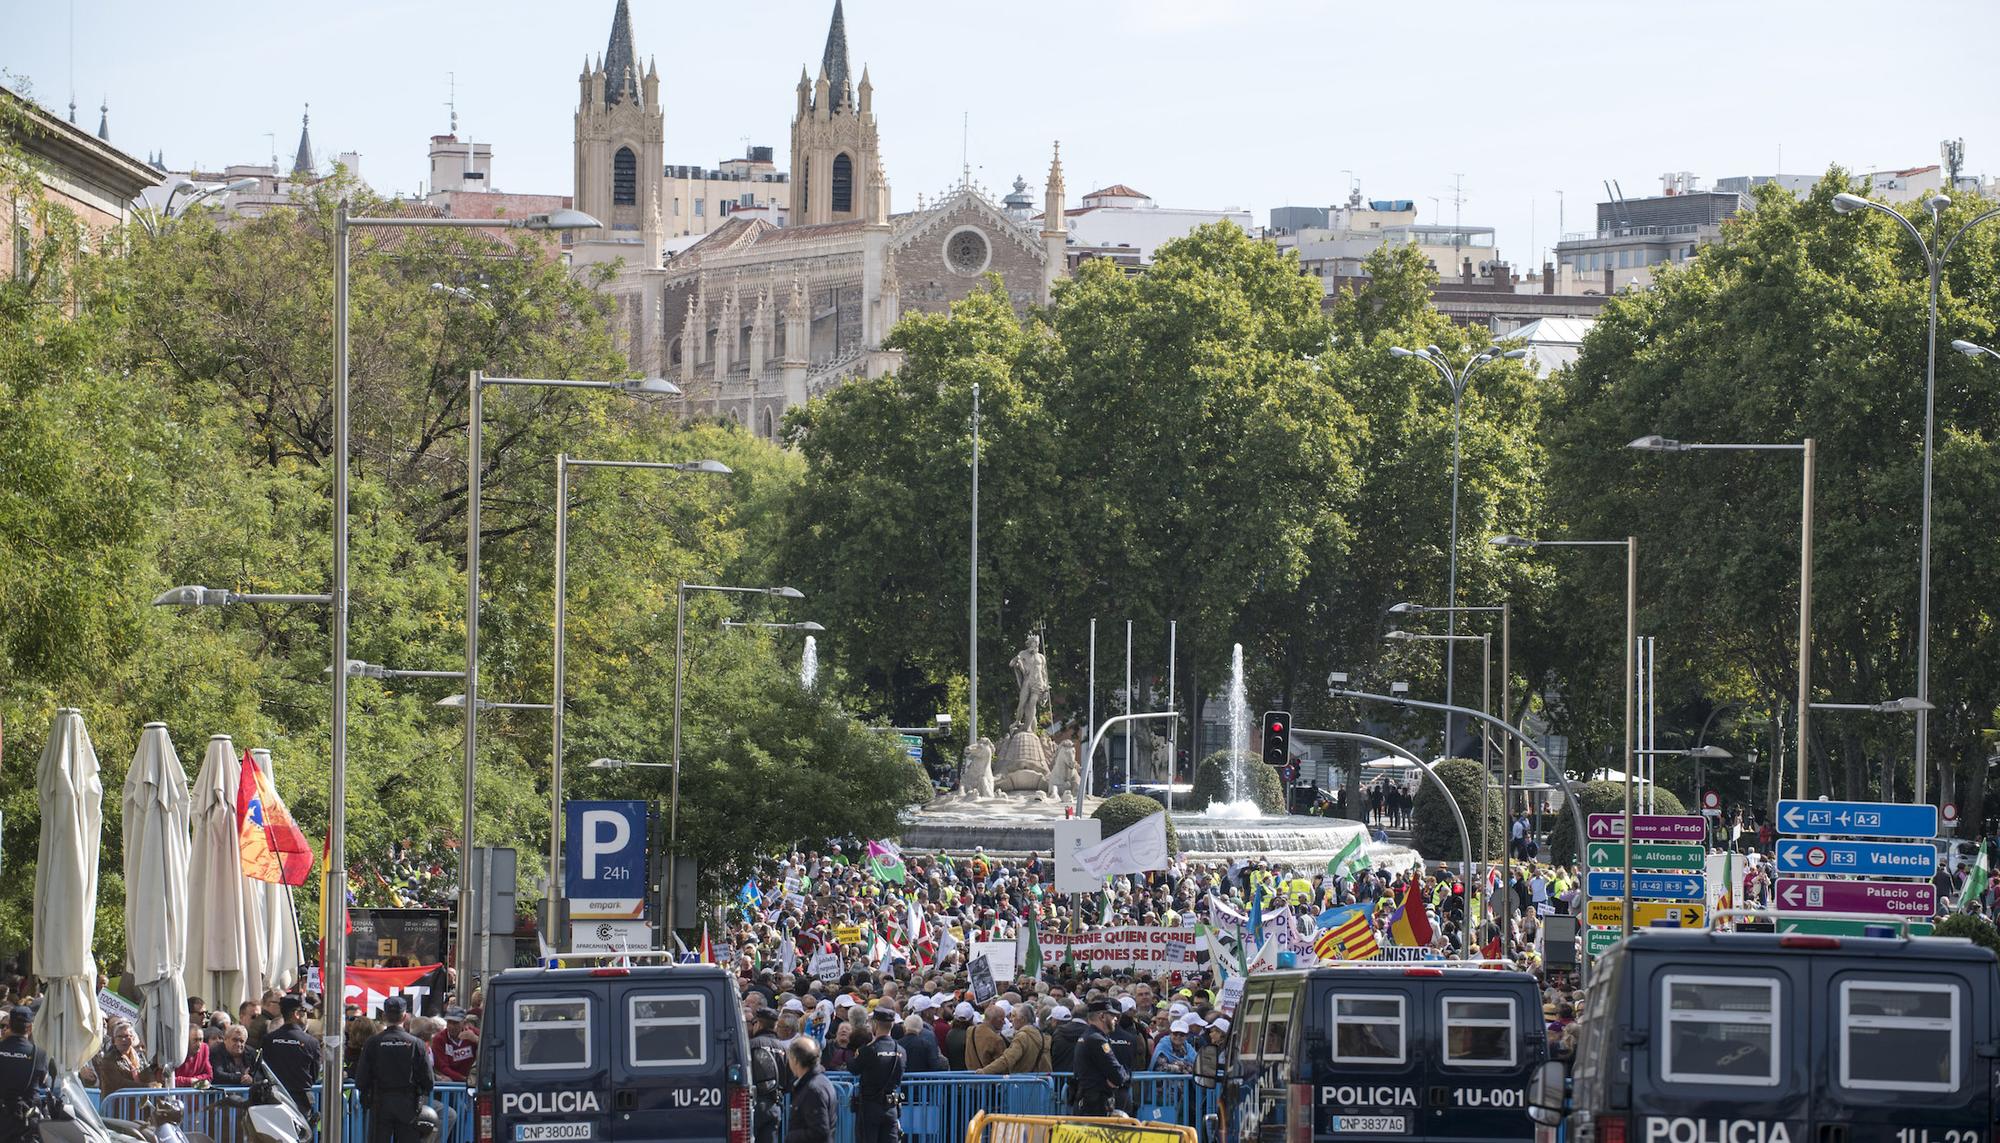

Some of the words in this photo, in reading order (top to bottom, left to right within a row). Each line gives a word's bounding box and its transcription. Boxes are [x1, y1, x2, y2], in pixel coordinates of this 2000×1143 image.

[1810, 814, 1829, 823] A-1
[1857, 815, 1878, 825] A-2
[1674, 824, 1701, 832] Prado
[582, 810, 630, 879] P
[1646, 852, 1682, 861] Alfonso
[1688, 854, 1701, 862] XII
[1833, 853, 1854, 863] R-3
[1871, 852, 1931, 866] Valencia
[603, 866, 630, 880] 24h
[1867, 887, 1909, 898] Palacio
[1916, 889, 1930, 899] de
[589, 901, 621, 910] empark
[1887, 900, 1930, 912] Cibeles
[1105, 931, 1147, 943] QUIEN
[1133, 949, 1148, 961] SE
[100, 993, 120, 1009] TODOS
[502, 1091, 600, 1114] POLICIA
[671, 1088, 722, 1107] 1U-20
[1321, 1086, 1417, 1106] POLICIA
[1453, 1088, 1524, 1107] 1U-001
[1646, 1117, 1791, 1143] POLICIA
